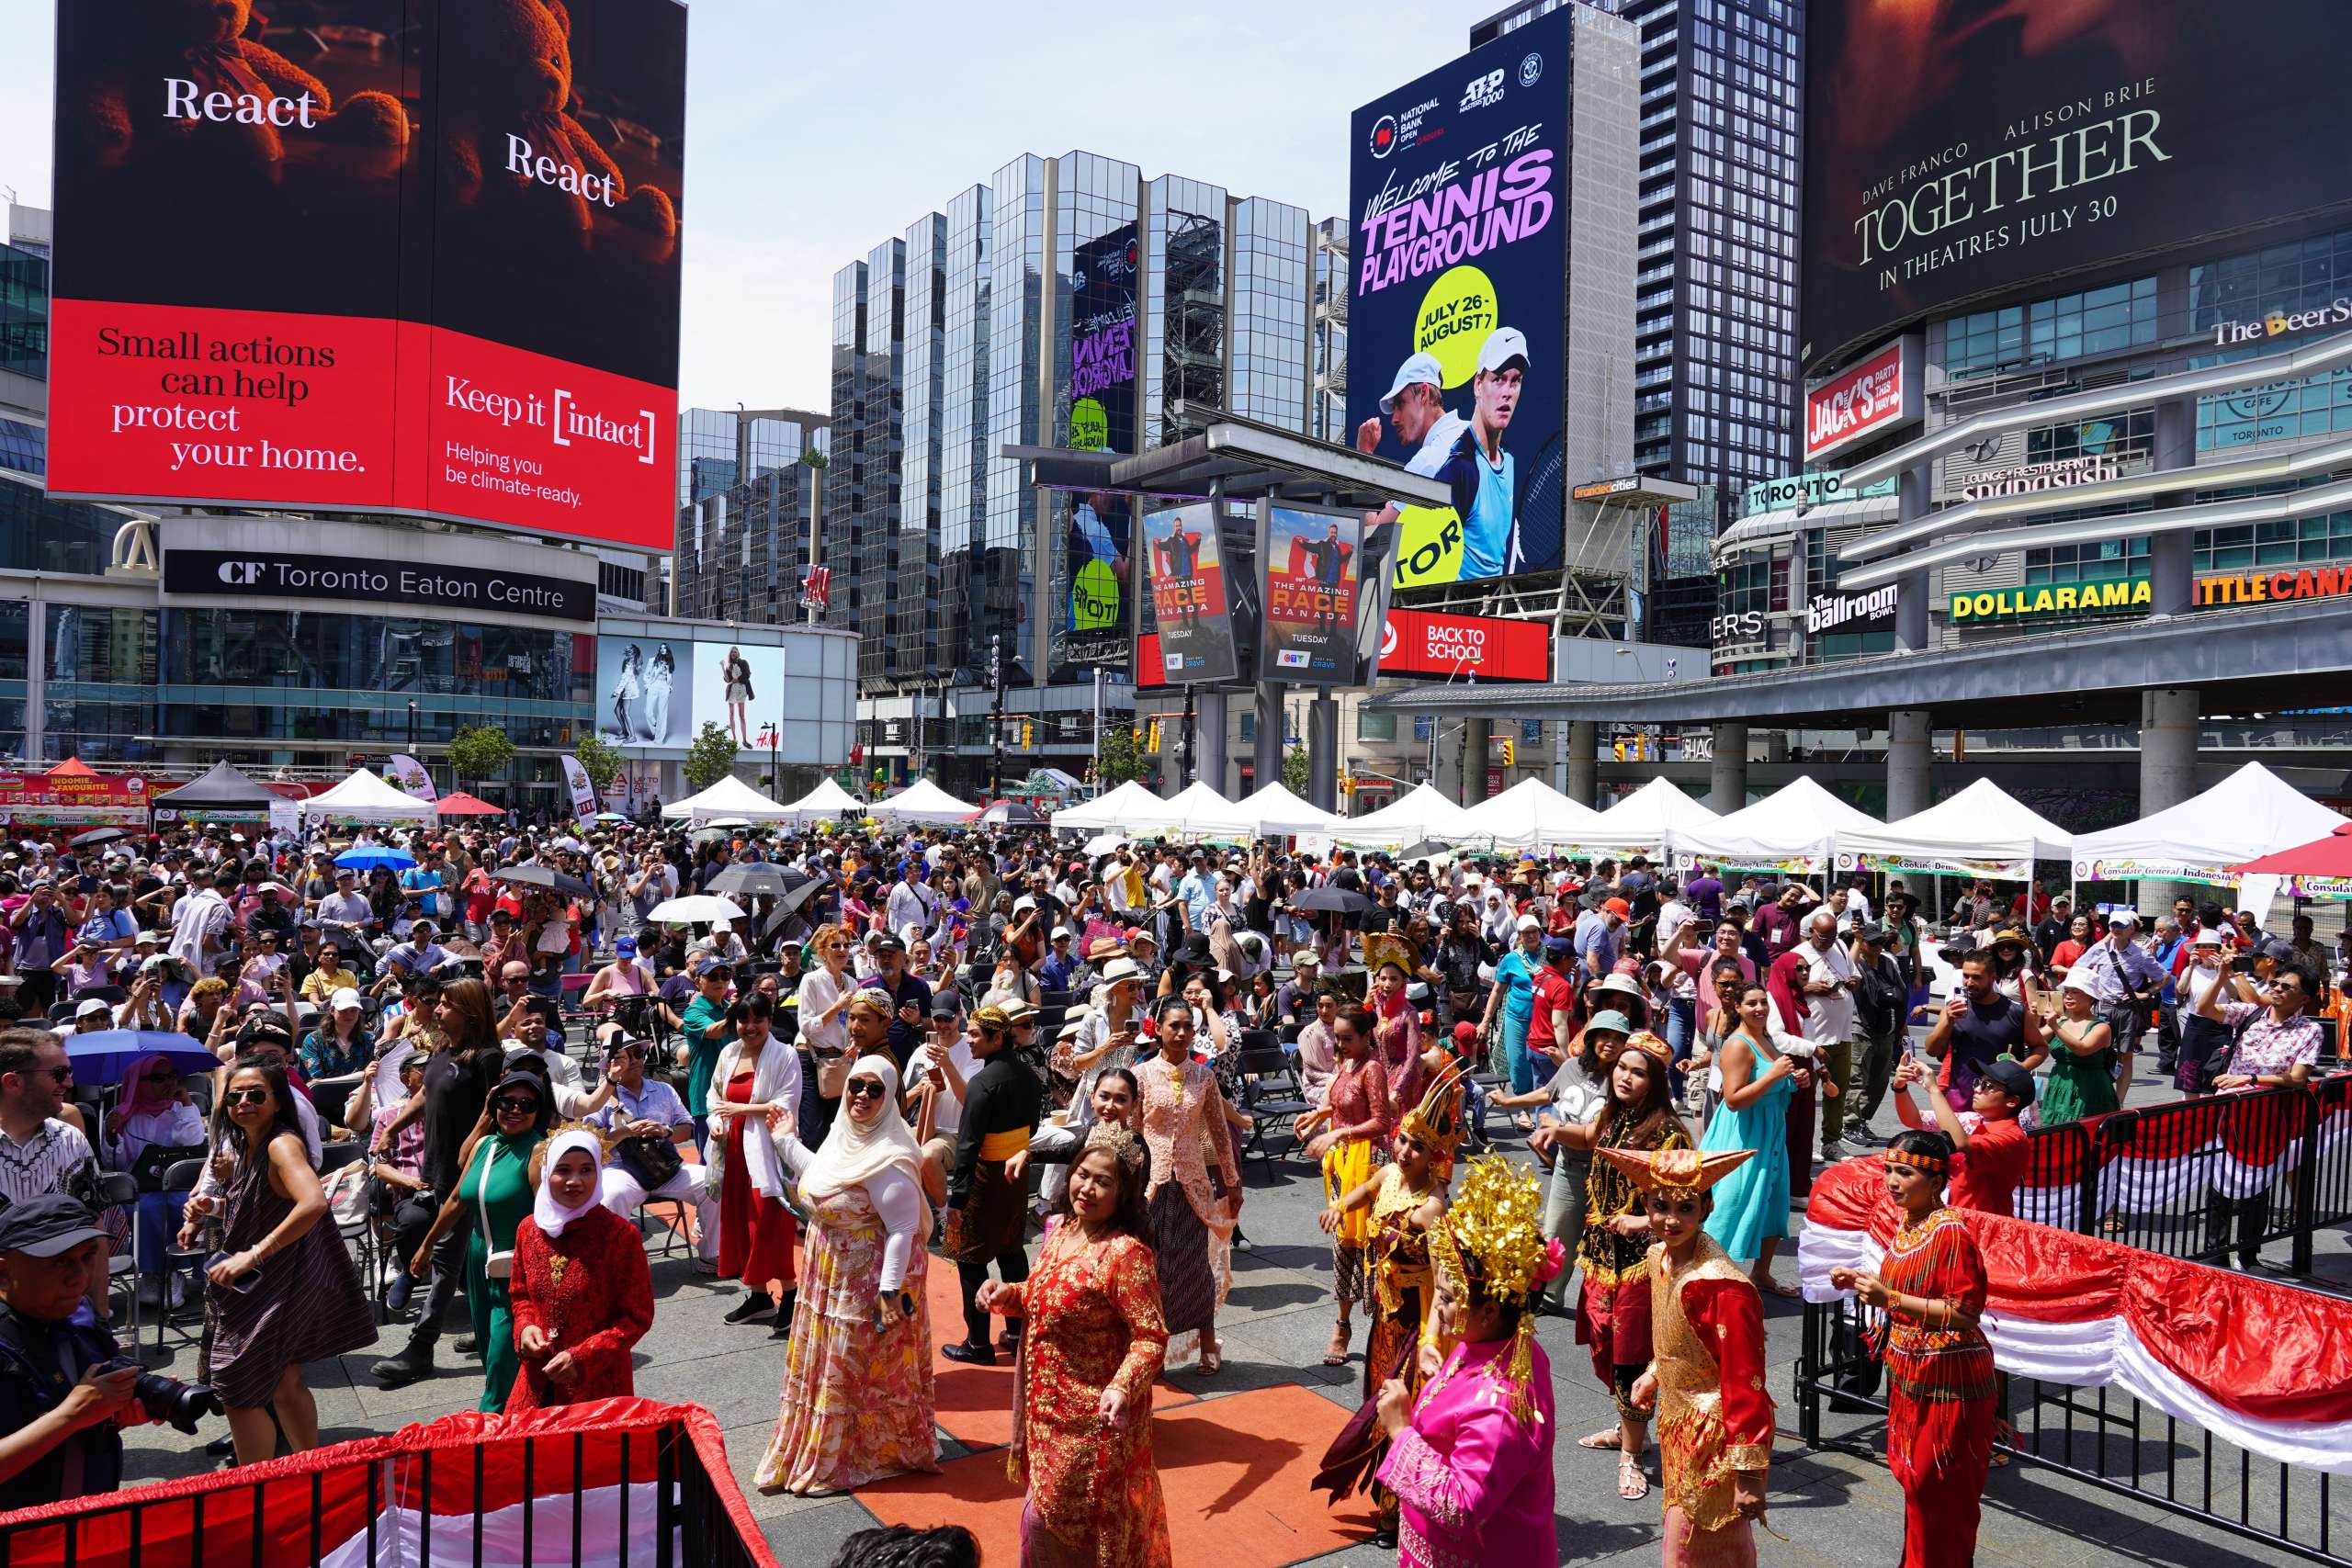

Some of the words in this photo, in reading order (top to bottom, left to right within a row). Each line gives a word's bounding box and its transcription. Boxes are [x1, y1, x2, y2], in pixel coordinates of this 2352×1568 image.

[1459, 68, 1505, 106] ATP
[1481, 88, 1505, 108] 1000
[163, 78, 317, 128] React
[1400, 97, 1440, 122] NATIONAL
[2006, 98, 2093, 139] ALISON
[2104, 76, 2156, 107] BRIE
[1400, 116, 1423, 133] BANK
[1400, 129, 1418, 142] OPEN
[504, 133, 616, 208] React
[1363, 161, 1459, 221] WELCOME
[1502, 123, 1543, 158] THE
[1863, 181, 1894, 205] DAVE
[1901, 142, 1969, 184] FRANCO
[1854, 108, 2171, 266] TOGETHER
[1361, 149, 1554, 257] TENNIS
[1359, 192, 1554, 296] PLAYGROUND
[1880, 266, 1897, 290] IN
[1904, 226, 2010, 276] THEATRES
[2020, 206, 2078, 244] JULY
[2088, 196, 2118, 222] 30
[1421, 299, 1460, 331] JULY
[2211, 321, 2263, 345] The
[97, 328, 201, 362] Small
[209, 333, 335, 369] actions
[1875, 362, 1896, 383] PARTY
[161, 371, 225, 396] can
[232, 370, 310, 407] help
[1875, 381, 1891, 398] THIS
[446, 376, 522, 427] Keep
[526, 396, 546, 426] it
[1811, 375, 1873, 444] JACK'S
[1875, 397, 1890, 412] WAY
[2244, 397, 2272, 409] CAFE
[111, 404, 241, 433] protect
[2233, 425, 2283, 441] TORONTO
[170, 443, 254, 471] your
[261, 438, 366, 474] home.
[446, 441, 510, 474] Helping
[513, 457, 543, 478] you
[1962, 468, 2007, 485] LOUNGE
[2013, 457, 2091, 478] RESTAURANT
[446, 464, 467, 485] be
[470, 468, 582, 508] climate-ready.
[1574, 479, 1636, 499] brandedcities
[1754, 477, 1839, 506] TORONTO
[218, 561, 266, 584] CF
[274, 564, 389, 592] Toronto
[401, 571, 477, 599] Eaton
[487, 580, 564, 609] Centre
[1163, 578, 1204, 591] AMAZING
[1274, 581, 1295, 591] THE
[1300, 585, 1350, 596] AMAZING
[1155, 586, 1206, 607] RACE
[1273, 590, 1349, 613] RACE
[1815, 593, 1833, 609] The
[1953, 581, 2151, 618] DOLLARAMA
[1157, 604, 1208, 616] CANADA
[1272, 607, 1347, 621] CANADA
[1808, 585, 1897, 634] ballroom
[1870, 606, 1895, 621] BOWL
[1167, 629, 1193, 639] TUESDAY
[1292, 634, 1329, 644] TUESDAY
[1428, 626, 1464, 643] BACK
[1465, 628, 1485, 645] TO
[1284, 653, 1304, 663] CTV
[1427, 643, 1482, 660] SCHOOL
[368, 754, 392, 762] Dunda
[1416, 769, 1427, 778] fido
[1726, 861, 1753, 870] Warung
[1898, 860, 1930, 872] Cooking
[1935, 862, 1960, 871] Demo
[2103, 866, 2143, 875] Consulate
[2144, 866, 2180, 876] General
[2183, 867, 2232, 882] Indonesia
[2306, 882, 2352, 894] Consula
